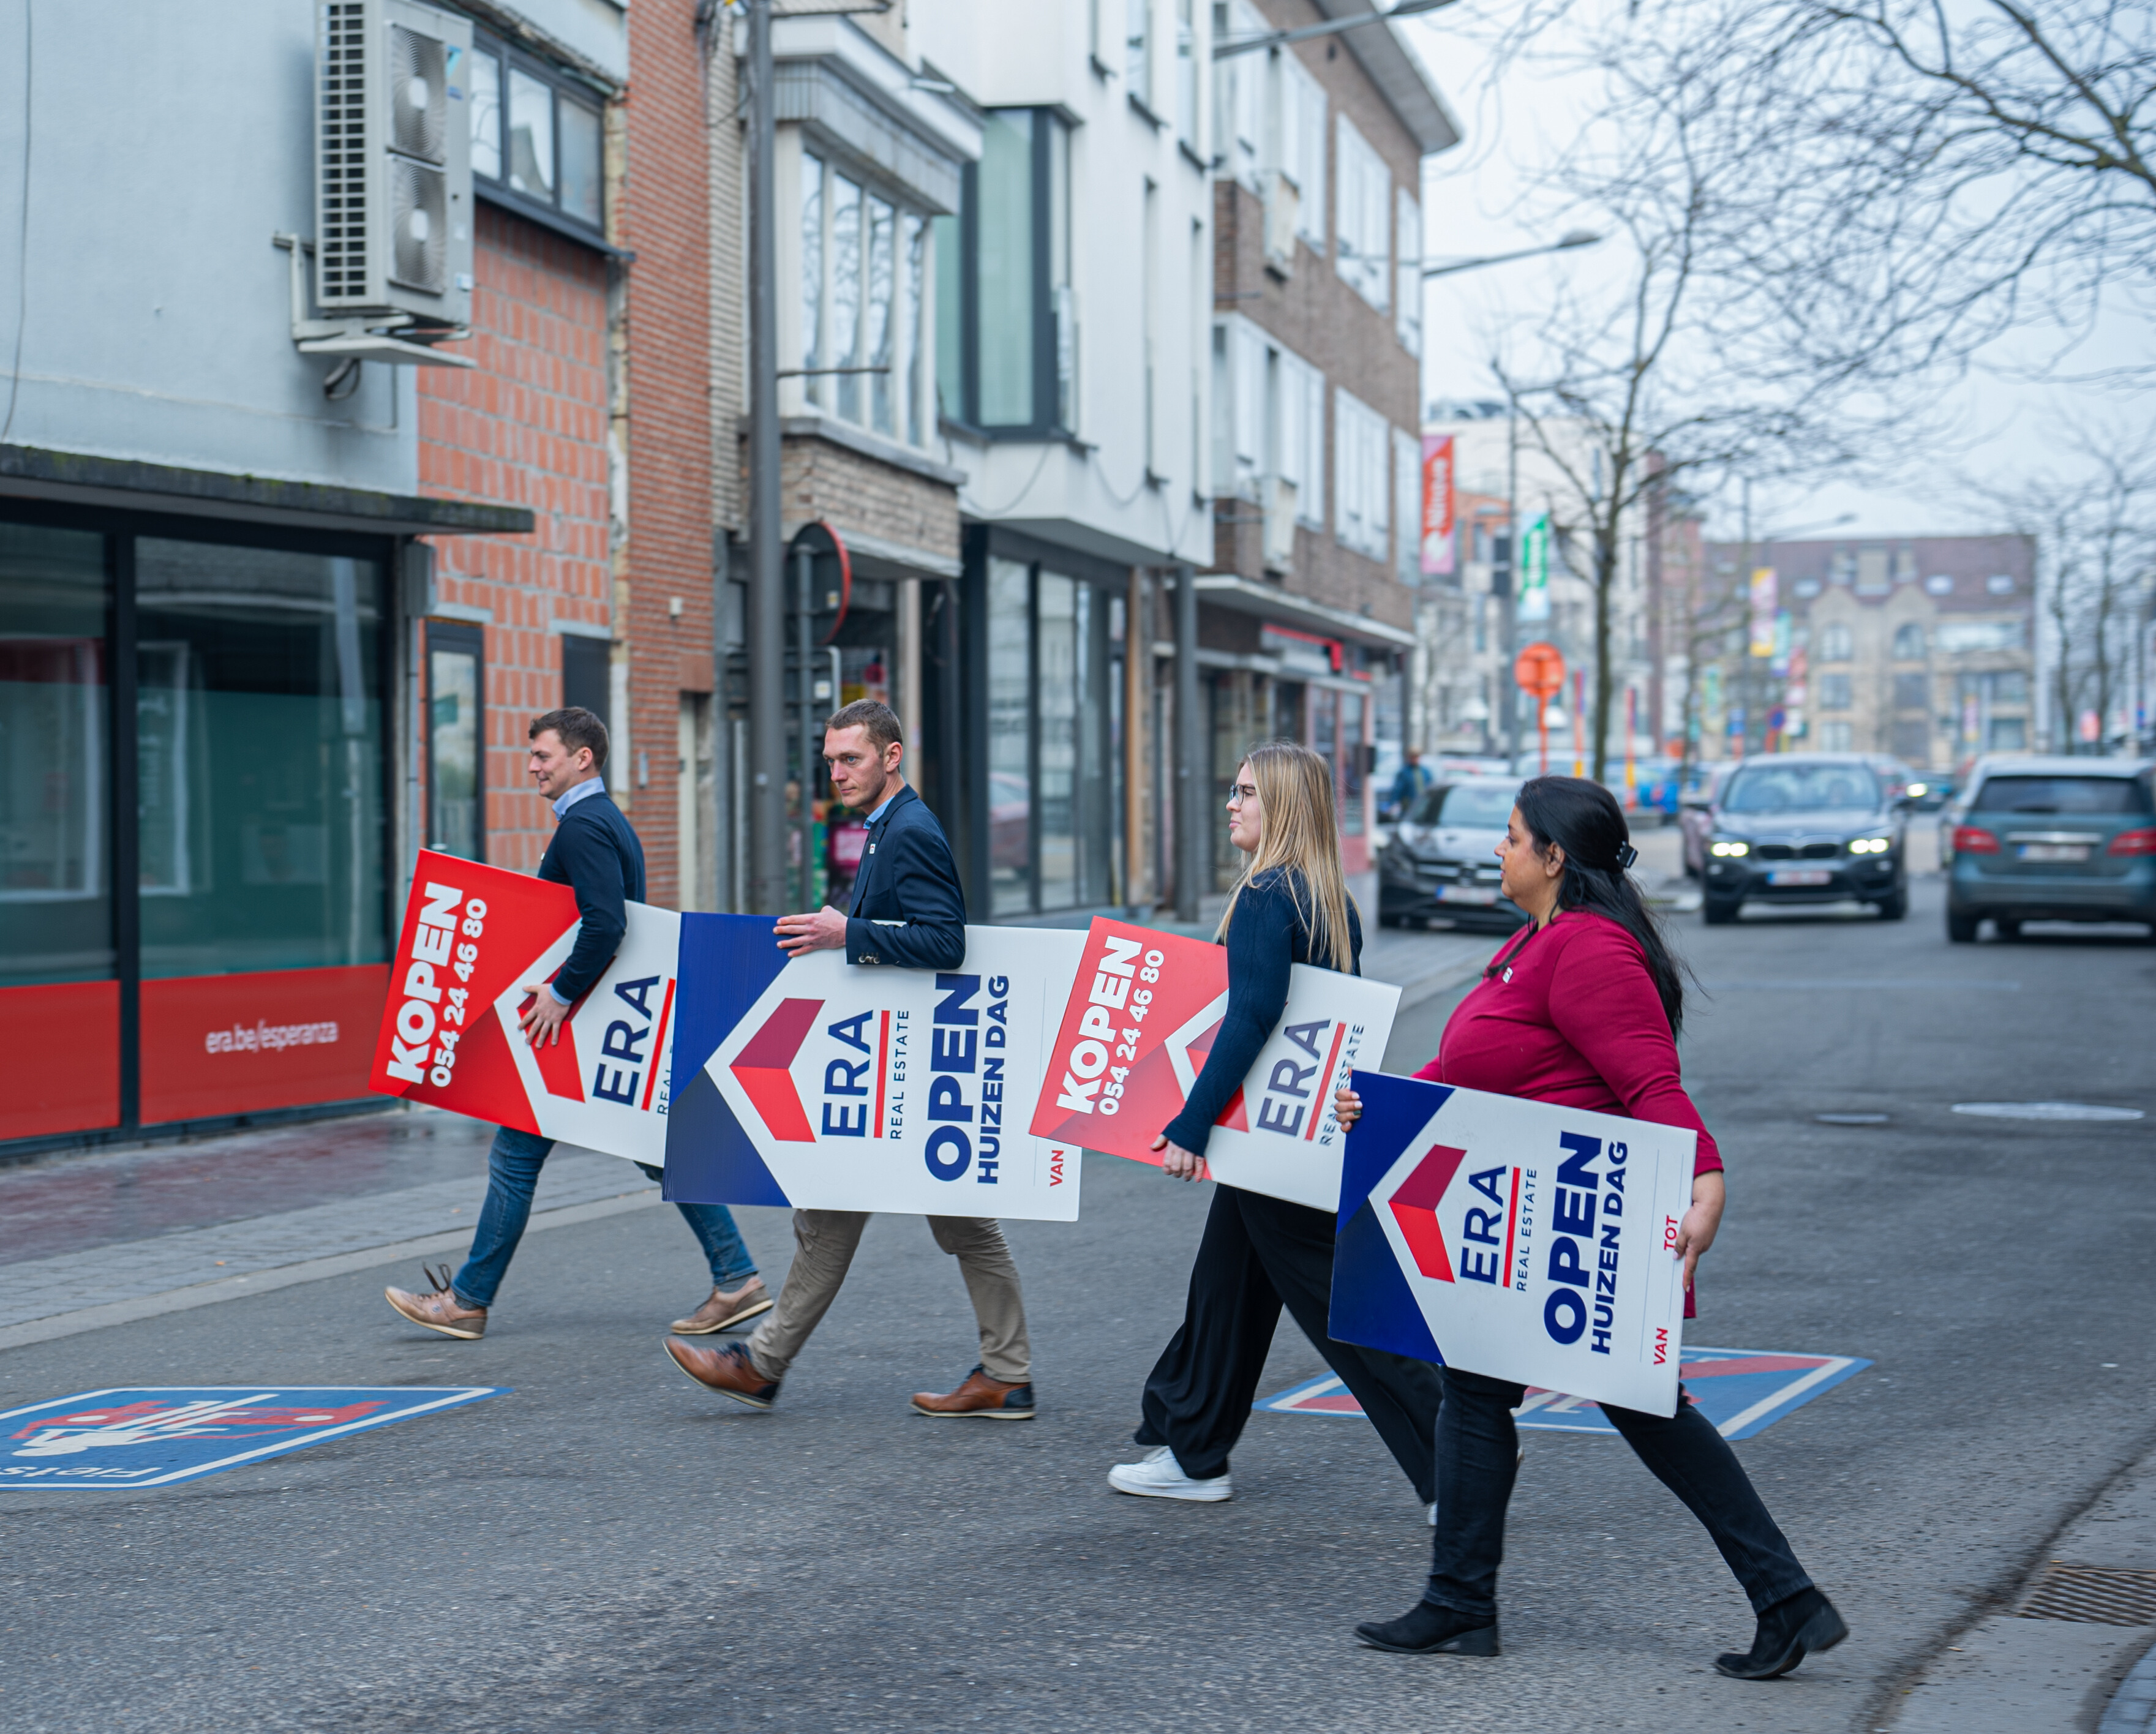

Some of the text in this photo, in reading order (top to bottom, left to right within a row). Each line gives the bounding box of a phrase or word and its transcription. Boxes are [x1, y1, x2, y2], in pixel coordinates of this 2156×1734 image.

[206, 1018, 338, 1054] era.be/esperanza
[386, 881, 463, 1084] KOPEN
[430, 898, 487, 1087] 054 24 46 80
[593, 975, 661, 1106] ERA
[1056, 936, 1143, 1114] KOPEN
[1098, 950, 1165, 1116] 054 24 46 80
[657, 1069, 671, 1114] REA
[821, 1009, 873, 1137] ERA
[890, 1010, 909, 1139] REAL ESTATE
[925, 972, 981, 1181] OPEN
[977, 976, 1009, 1184] HUIZEN DAG
[1256, 1019, 1331, 1136] ERA
[1319, 1104, 1337, 1146] REA
[1050, 1150, 1064, 1187] VAN
[1460, 1165, 1507, 1285] ERA
[1516, 1168, 1537, 1292] REAL ESTATE
[1544, 1130, 1602, 1345] OPEN
[1591, 1141, 1628, 1355] HUIZEN DAG
[1653, 1215, 1678, 1365] VAN TOT
